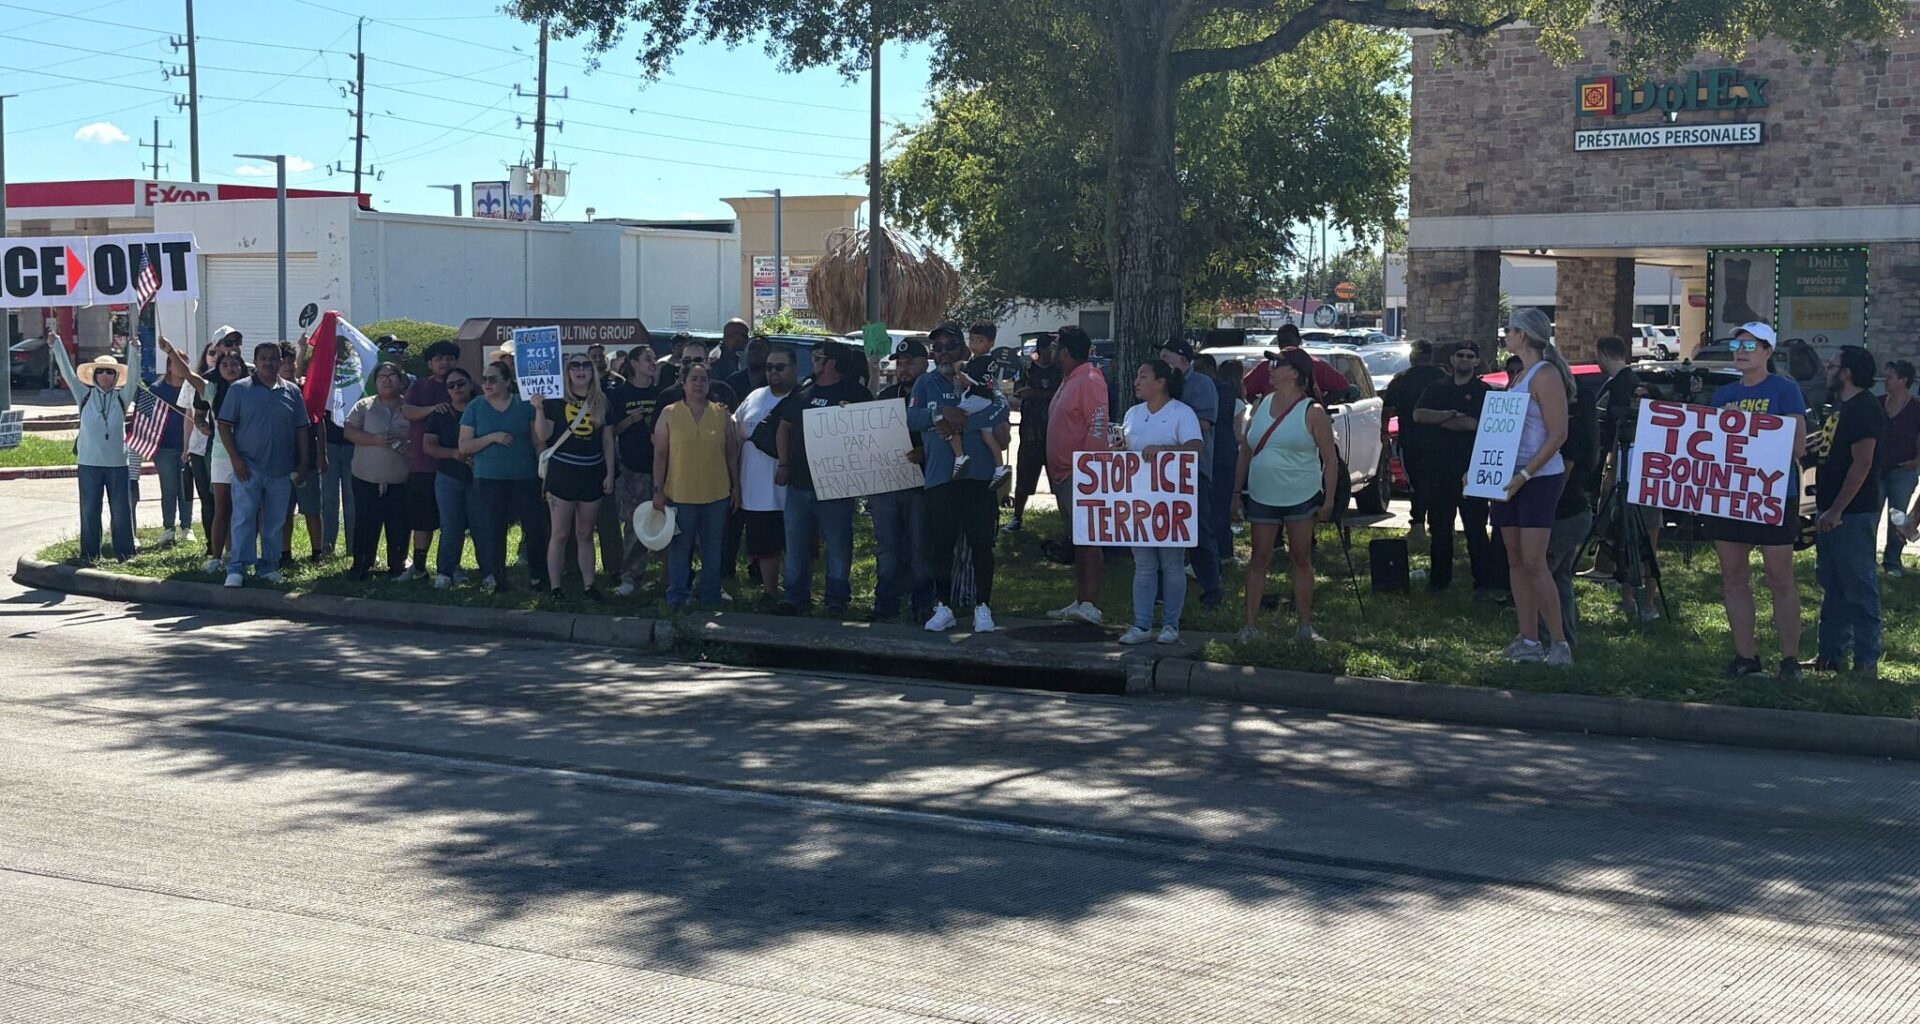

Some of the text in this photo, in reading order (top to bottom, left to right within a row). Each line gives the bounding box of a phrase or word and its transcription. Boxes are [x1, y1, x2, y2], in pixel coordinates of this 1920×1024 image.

[1614, 68, 1770, 116] DolEx
[1578, 126, 1757, 149] PRÉSTAMOS PERSONALES
[145, 183, 211, 206] Exxon
[0, 241, 191, 298] CE OUT
[1808, 255, 1850, 269] DolEx
[561, 325, 597, 341] ULTING
[599, 325, 636, 340] GROUP
[526, 346, 556, 359] ICE!
[528, 360, 552, 371] NOT
[520, 376, 555, 387] HUMAN
[526, 385, 560, 396] LIVES!
[1487, 397, 1522, 415] RENEE
[813, 406, 905, 439] JUSTICIA
[1483, 417, 1516, 433] GOOD
[1649, 400, 1784, 438] STOP
[843, 434, 880, 453] PARA
[1664, 428, 1749, 466] ICE
[813, 453, 865, 475] MIGUEL
[1480, 449, 1505, 466] ICE
[1076, 452, 1195, 495] STOP ICE
[1476, 469, 1503, 486] BAD
[1642, 451, 1785, 497] BOUNTY
[1638, 477, 1783, 526] HUNTERS
[1076, 499, 1193, 543] TERROR
